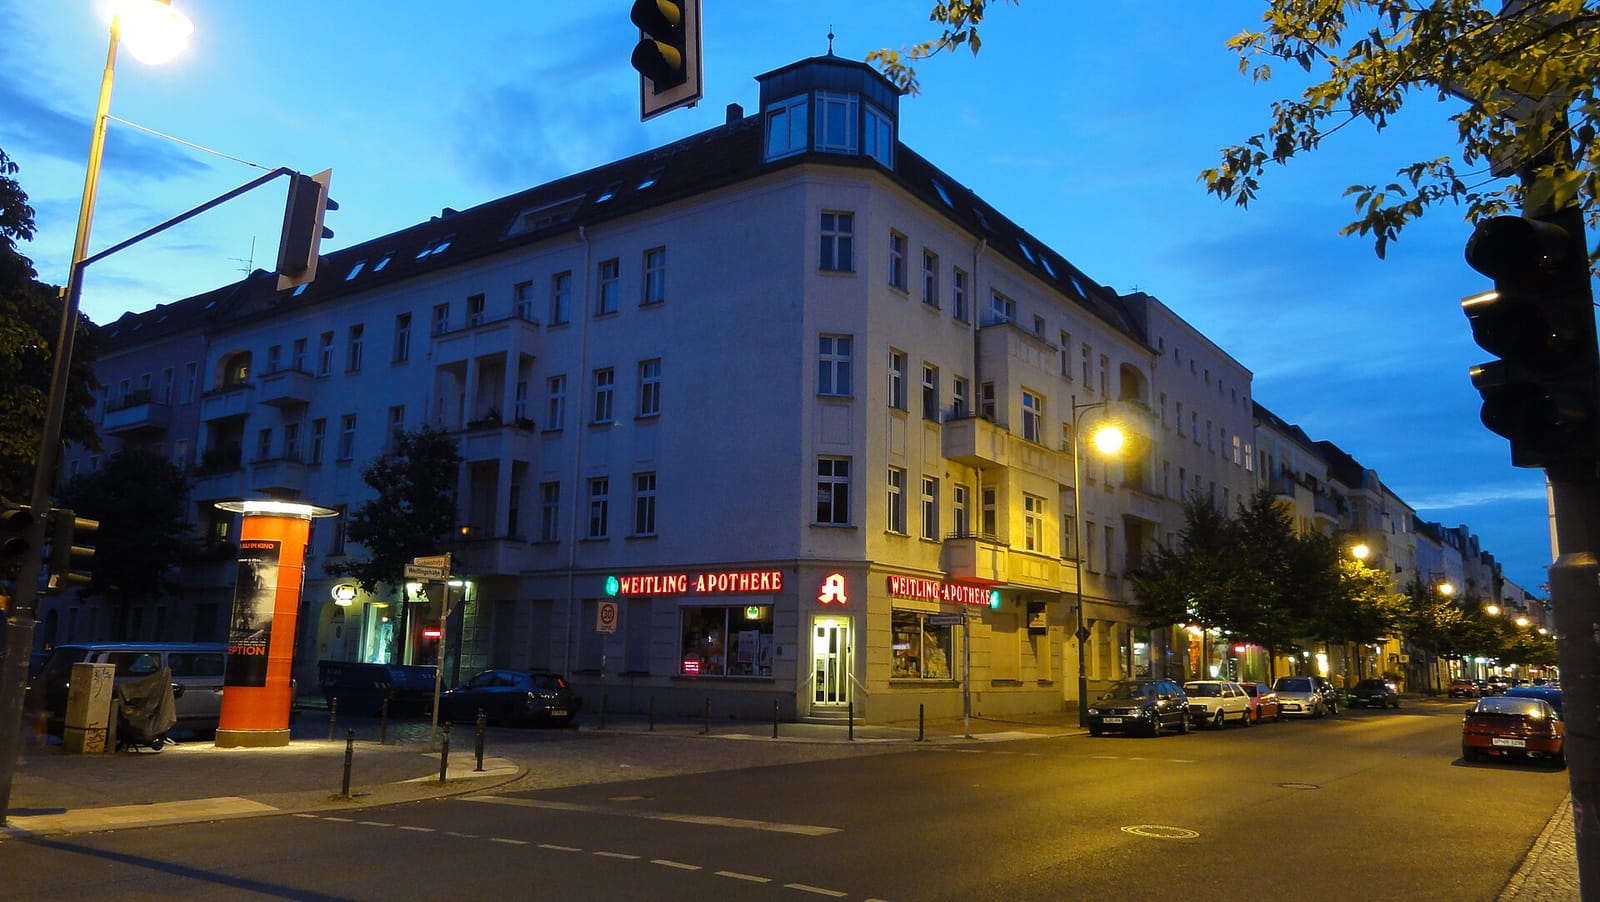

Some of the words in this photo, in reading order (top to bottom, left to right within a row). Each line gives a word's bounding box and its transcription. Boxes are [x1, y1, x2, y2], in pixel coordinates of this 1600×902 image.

[620, 574, 688, 594] WEITLING
[891, 576, 940, 599] WEITLING
[604, 608, 612, 619] 30
